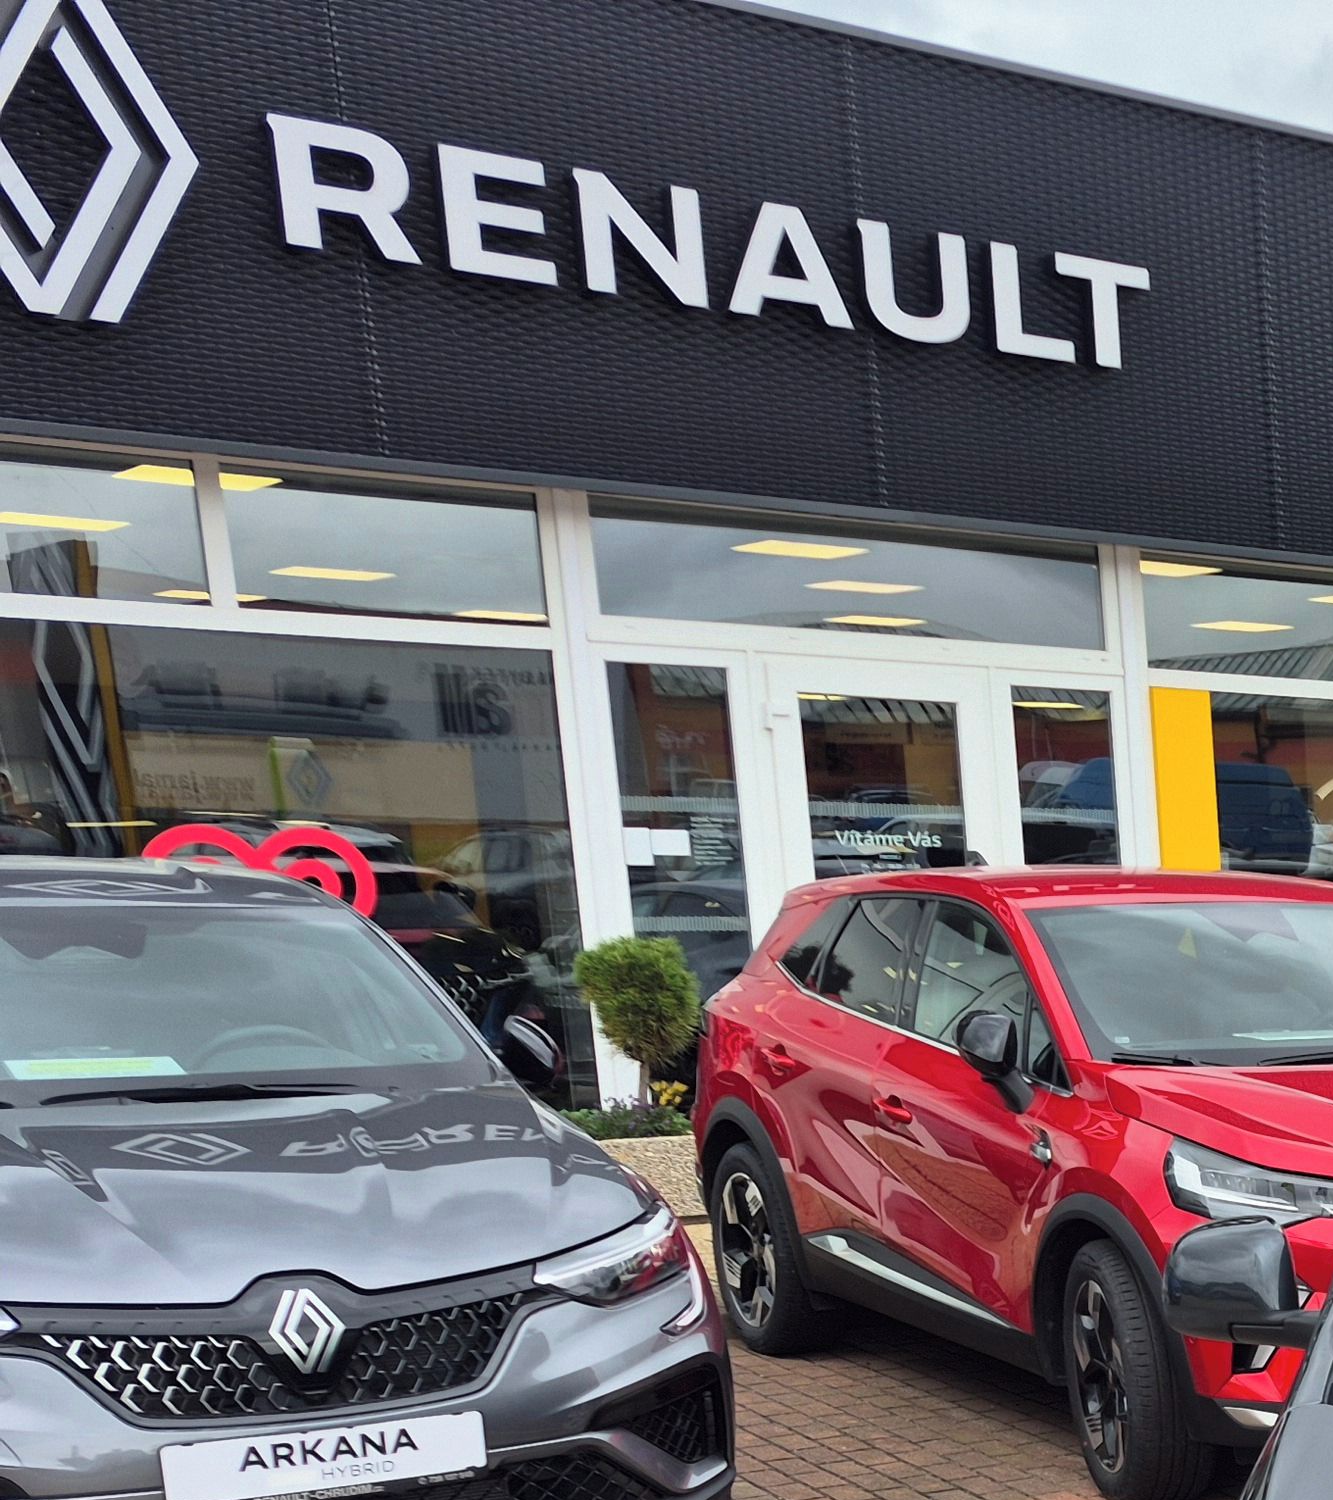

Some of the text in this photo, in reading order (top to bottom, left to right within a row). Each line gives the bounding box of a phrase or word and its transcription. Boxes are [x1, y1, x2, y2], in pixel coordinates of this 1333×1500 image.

[266, 112, 1150, 369] RENAULT
[239, 1427, 419, 1471] ARKANA
[321, 1460, 396, 1480] HYBRID
